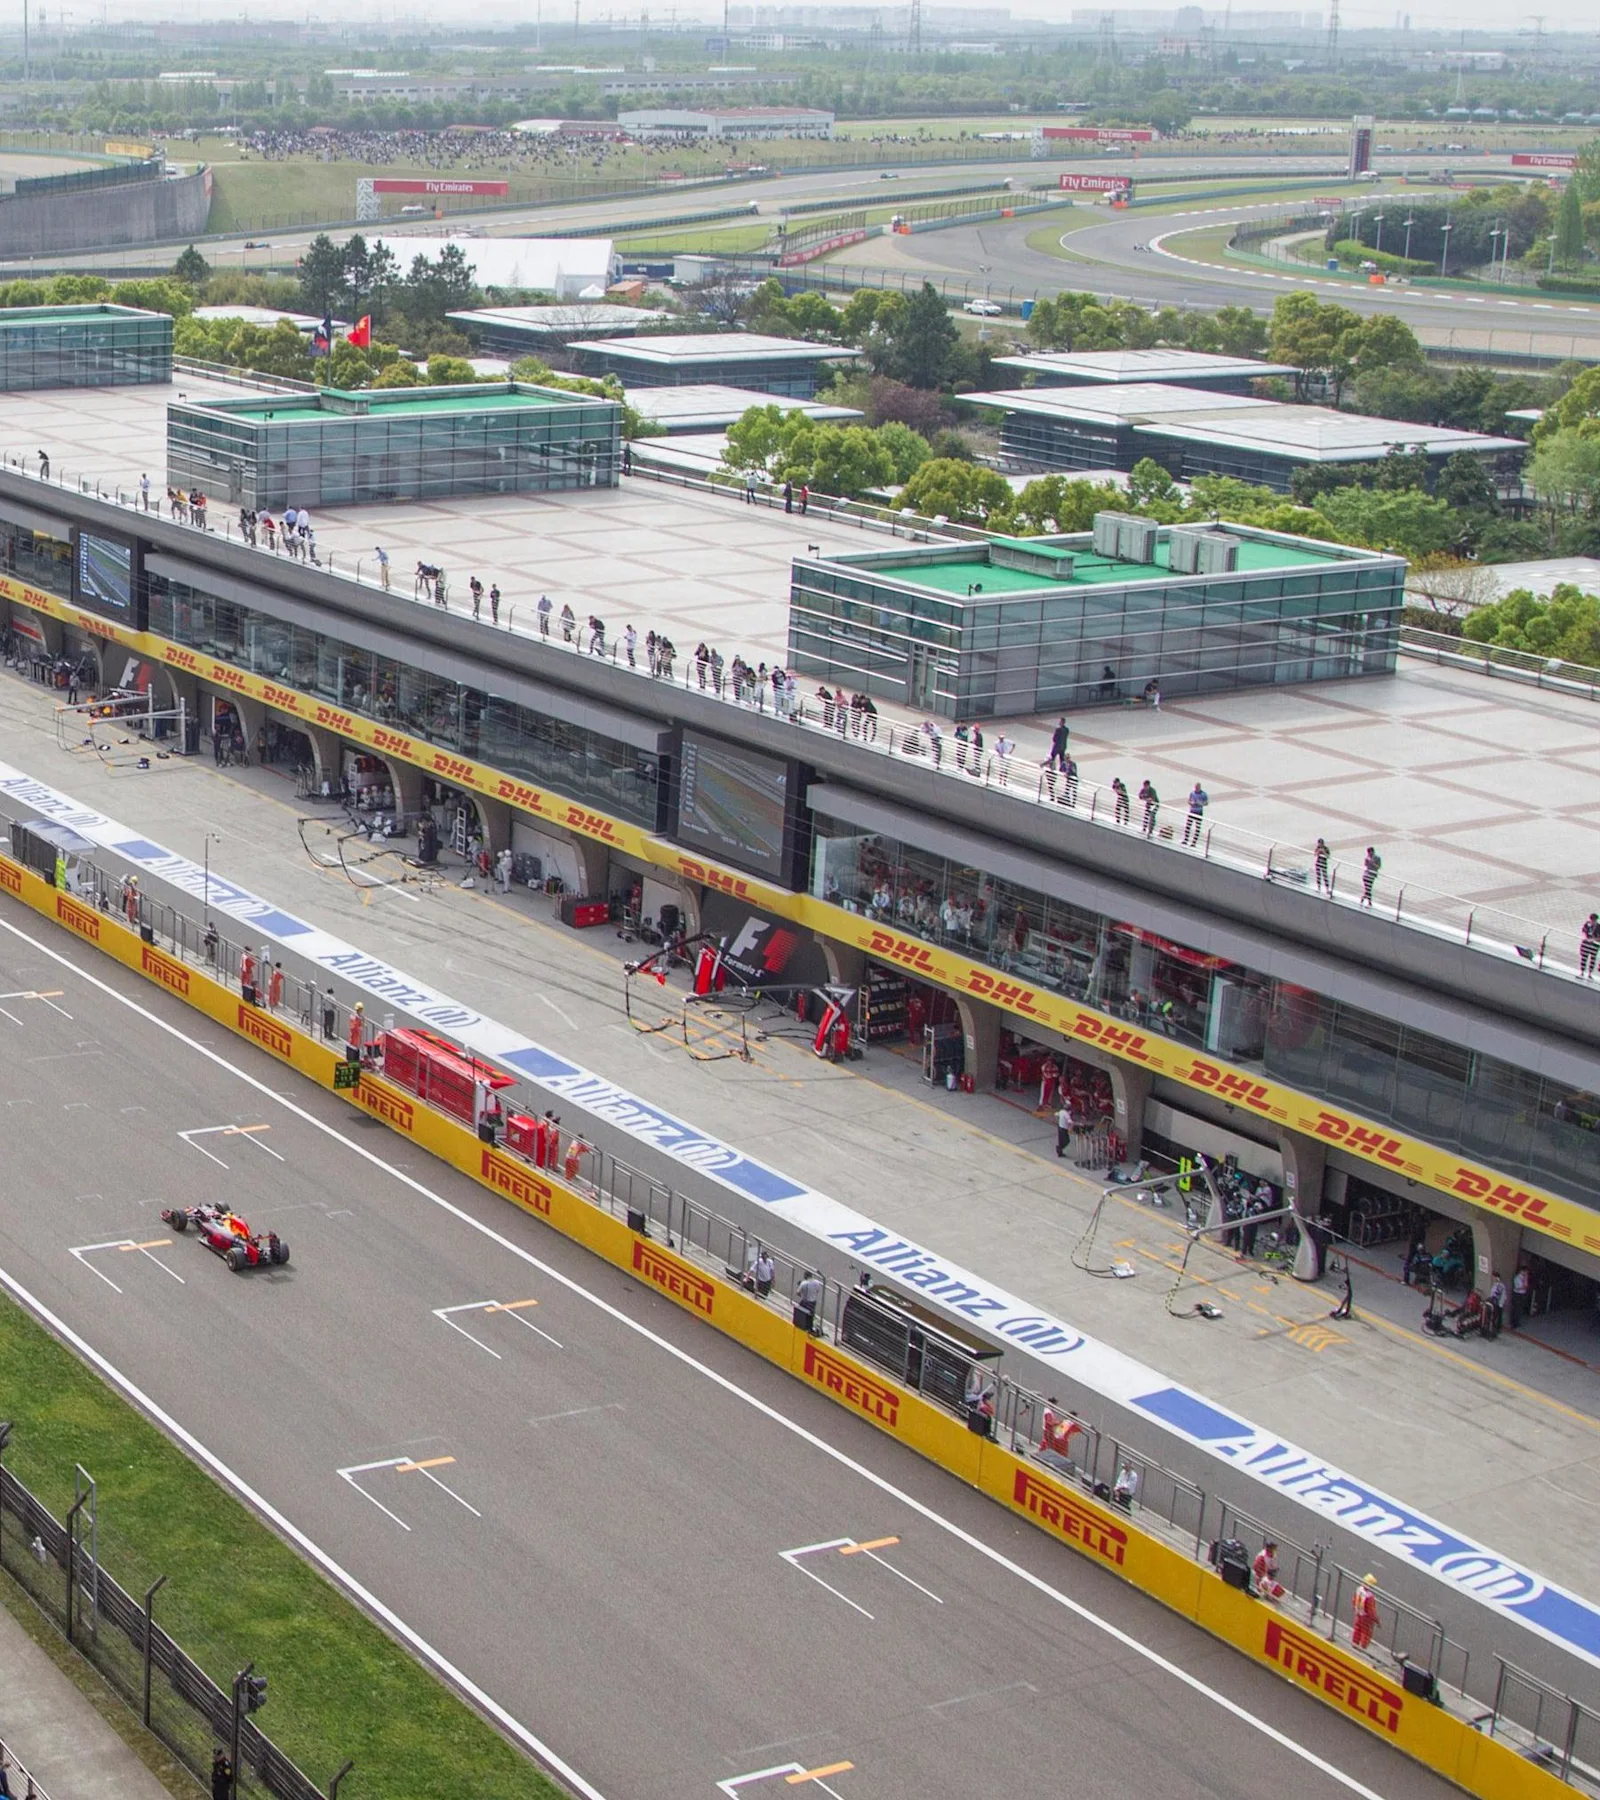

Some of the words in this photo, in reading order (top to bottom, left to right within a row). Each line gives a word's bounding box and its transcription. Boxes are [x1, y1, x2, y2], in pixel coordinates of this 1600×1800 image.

[426, 182, 439, 193] Fly
[440, 182, 473, 192] Emirates
[1062, 175, 1080, 189] Fly
[24, 589, 49, 610] DHL
[166, 646, 199, 670] DHL
[213, 665, 247, 690] DHL
[263, 685, 299, 711] DHL
[317, 706, 354, 733] DHL
[374, 729, 412, 757] DHL
[433, 753, 475, 784] DHL
[498, 779, 542, 811] DHL
[567, 806, 615, 841] DHL
[148, 857, 240, 904] Allianz
[56, 896, 100, 941] PIRELLI
[141, 946, 190, 996] PIRELLI
[724, 955, 755, 975] Formula
[869, 930, 937, 973] DHL
[318, 952, 436, 1007] Allianz
[967, 969, 1039, 1014] DHL
[237, 1004, 292, 1058] PIRELLI
[1073, 1013, 1153, 1062] DHL
[539, 1072, 684, 1144] Allianz
[1187, 1060, 1276, 1112] DHL
[1315, 1112, 1406, 1167] DHL
[480, 1149, 552, 1216] PIRELLI
[1452, 1168, 1554, 1230] DHL
[632, 1239, 715, 1316] PIRELLI
[828, 1228, 1008, 1318] Allianz
[803, 1342, 900, 1428] PIRELLI
[1200, 1430, 1443, 1556] Allianz
[1012, 1467, 1128, 1567] PIRELLI
[1264, 1619, 1404, 1735] PIRELLI
